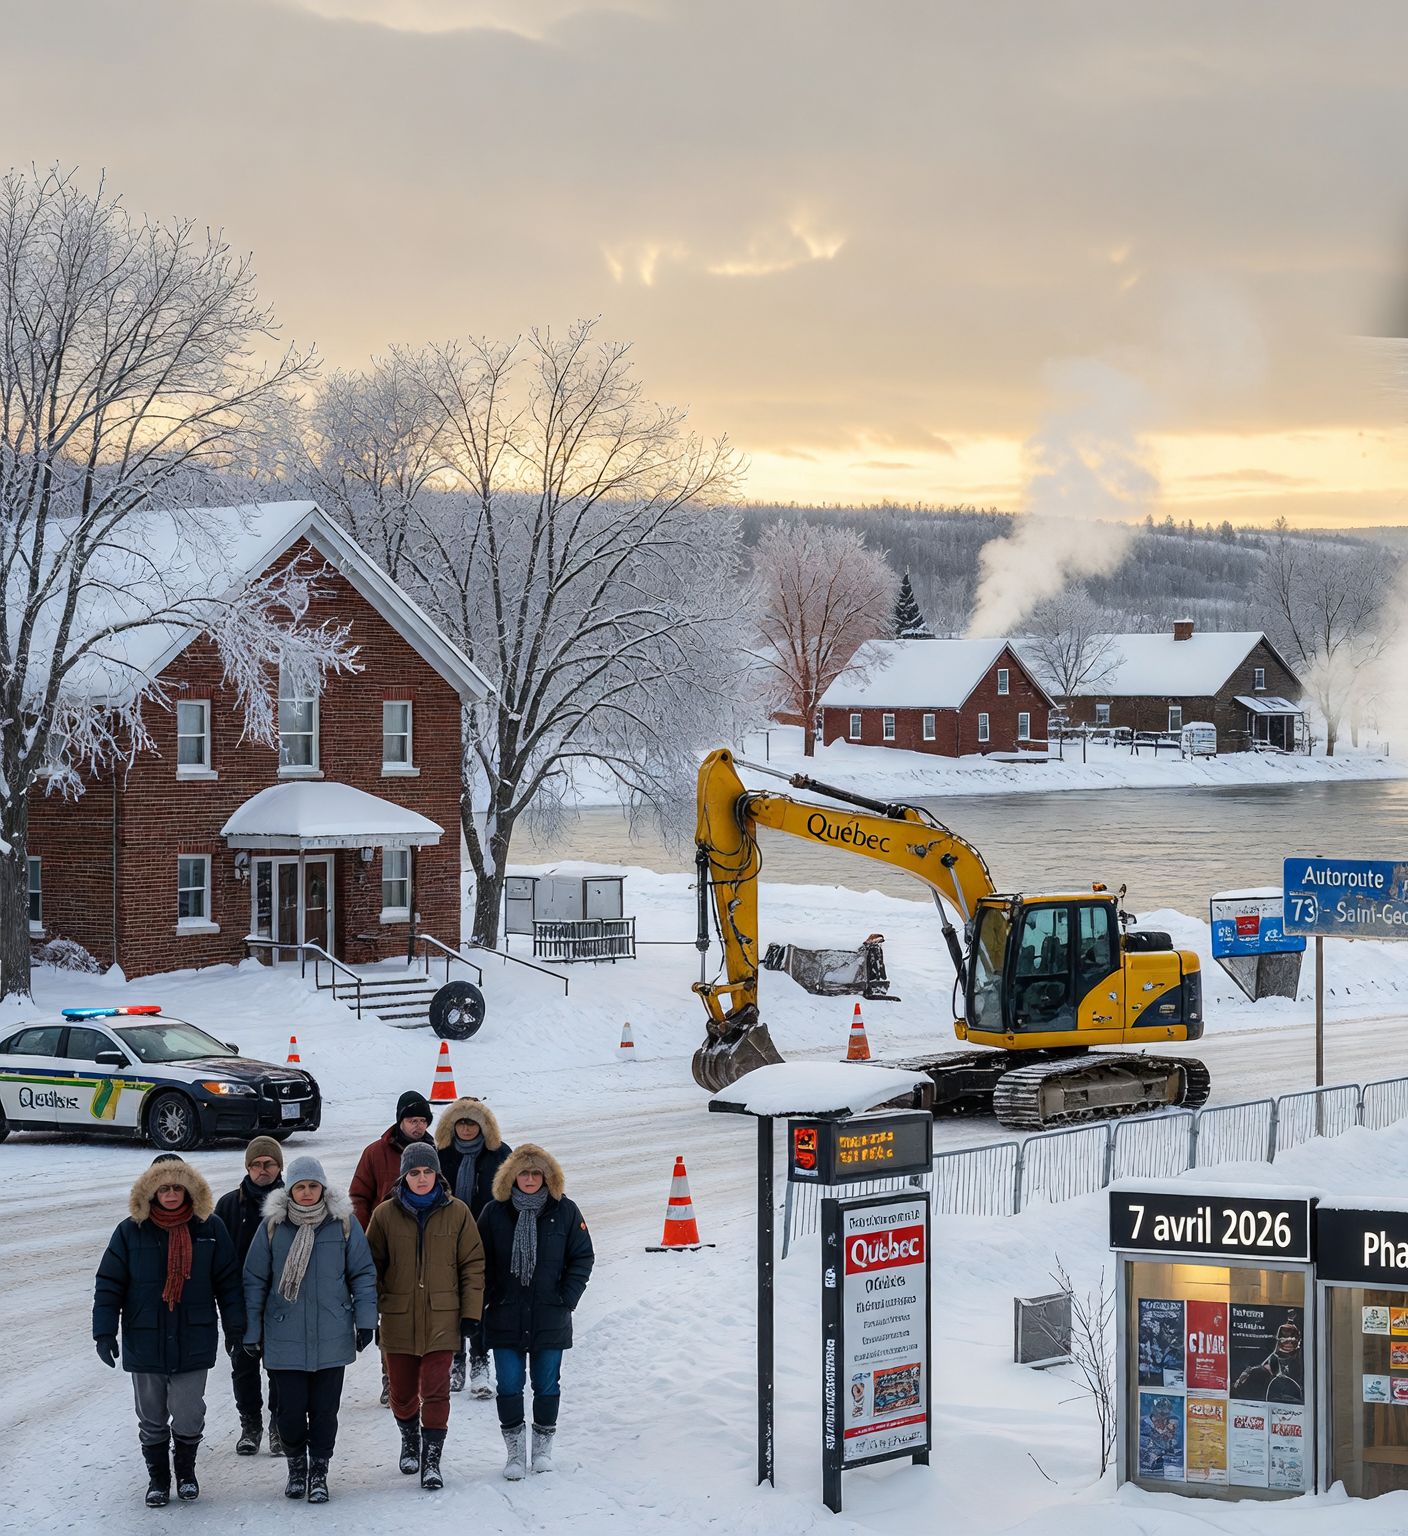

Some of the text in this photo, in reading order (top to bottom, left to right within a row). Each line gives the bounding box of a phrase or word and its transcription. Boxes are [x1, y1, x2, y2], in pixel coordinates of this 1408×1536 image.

[807, 813, 890, 852] Québec
[1302, 866, 1383, 889] Autoroute
[1128, 1205, 1292, 1247] 7 avril 2026
